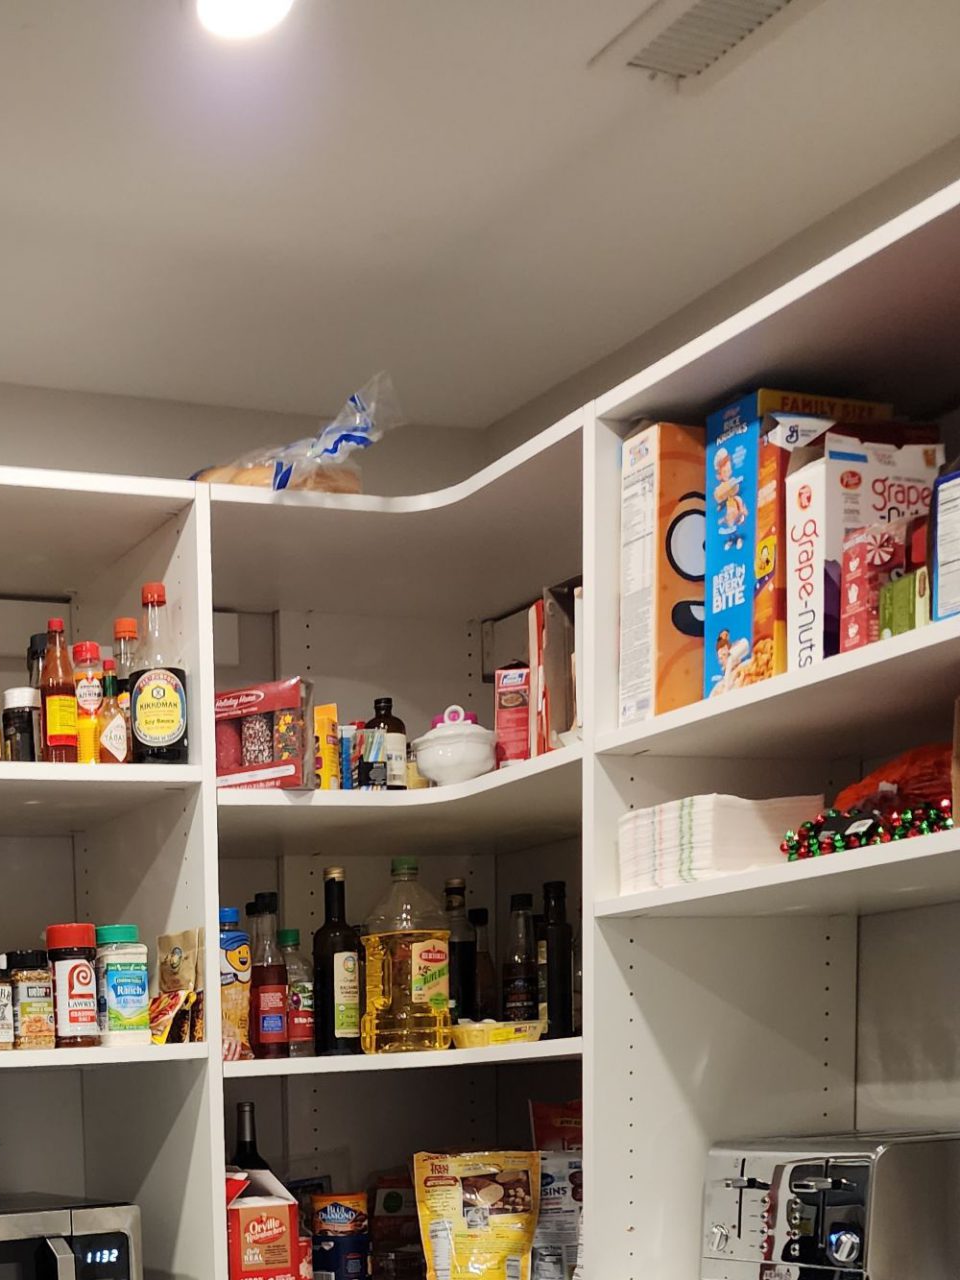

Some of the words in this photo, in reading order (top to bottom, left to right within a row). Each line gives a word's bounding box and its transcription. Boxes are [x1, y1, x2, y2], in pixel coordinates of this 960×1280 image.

[780, 395, 837, 415] FAMILY
[841, 401, 876, 418] SIZE
[872, 477, 932, 512] grape
[712, 569, 735, 586] BEST
[713, 575, 746, 597] EVERY
[712, 591, 746, 615] BITE
[140, 700, 178, 711] KIKKOMAN
[117, 985, 143, 996] Ranch
[541, 1186, 567, 1197] SINS
[318, 1210, 356, 1221] DIAMOND
[249, 1218, 280, 1234] Orville
